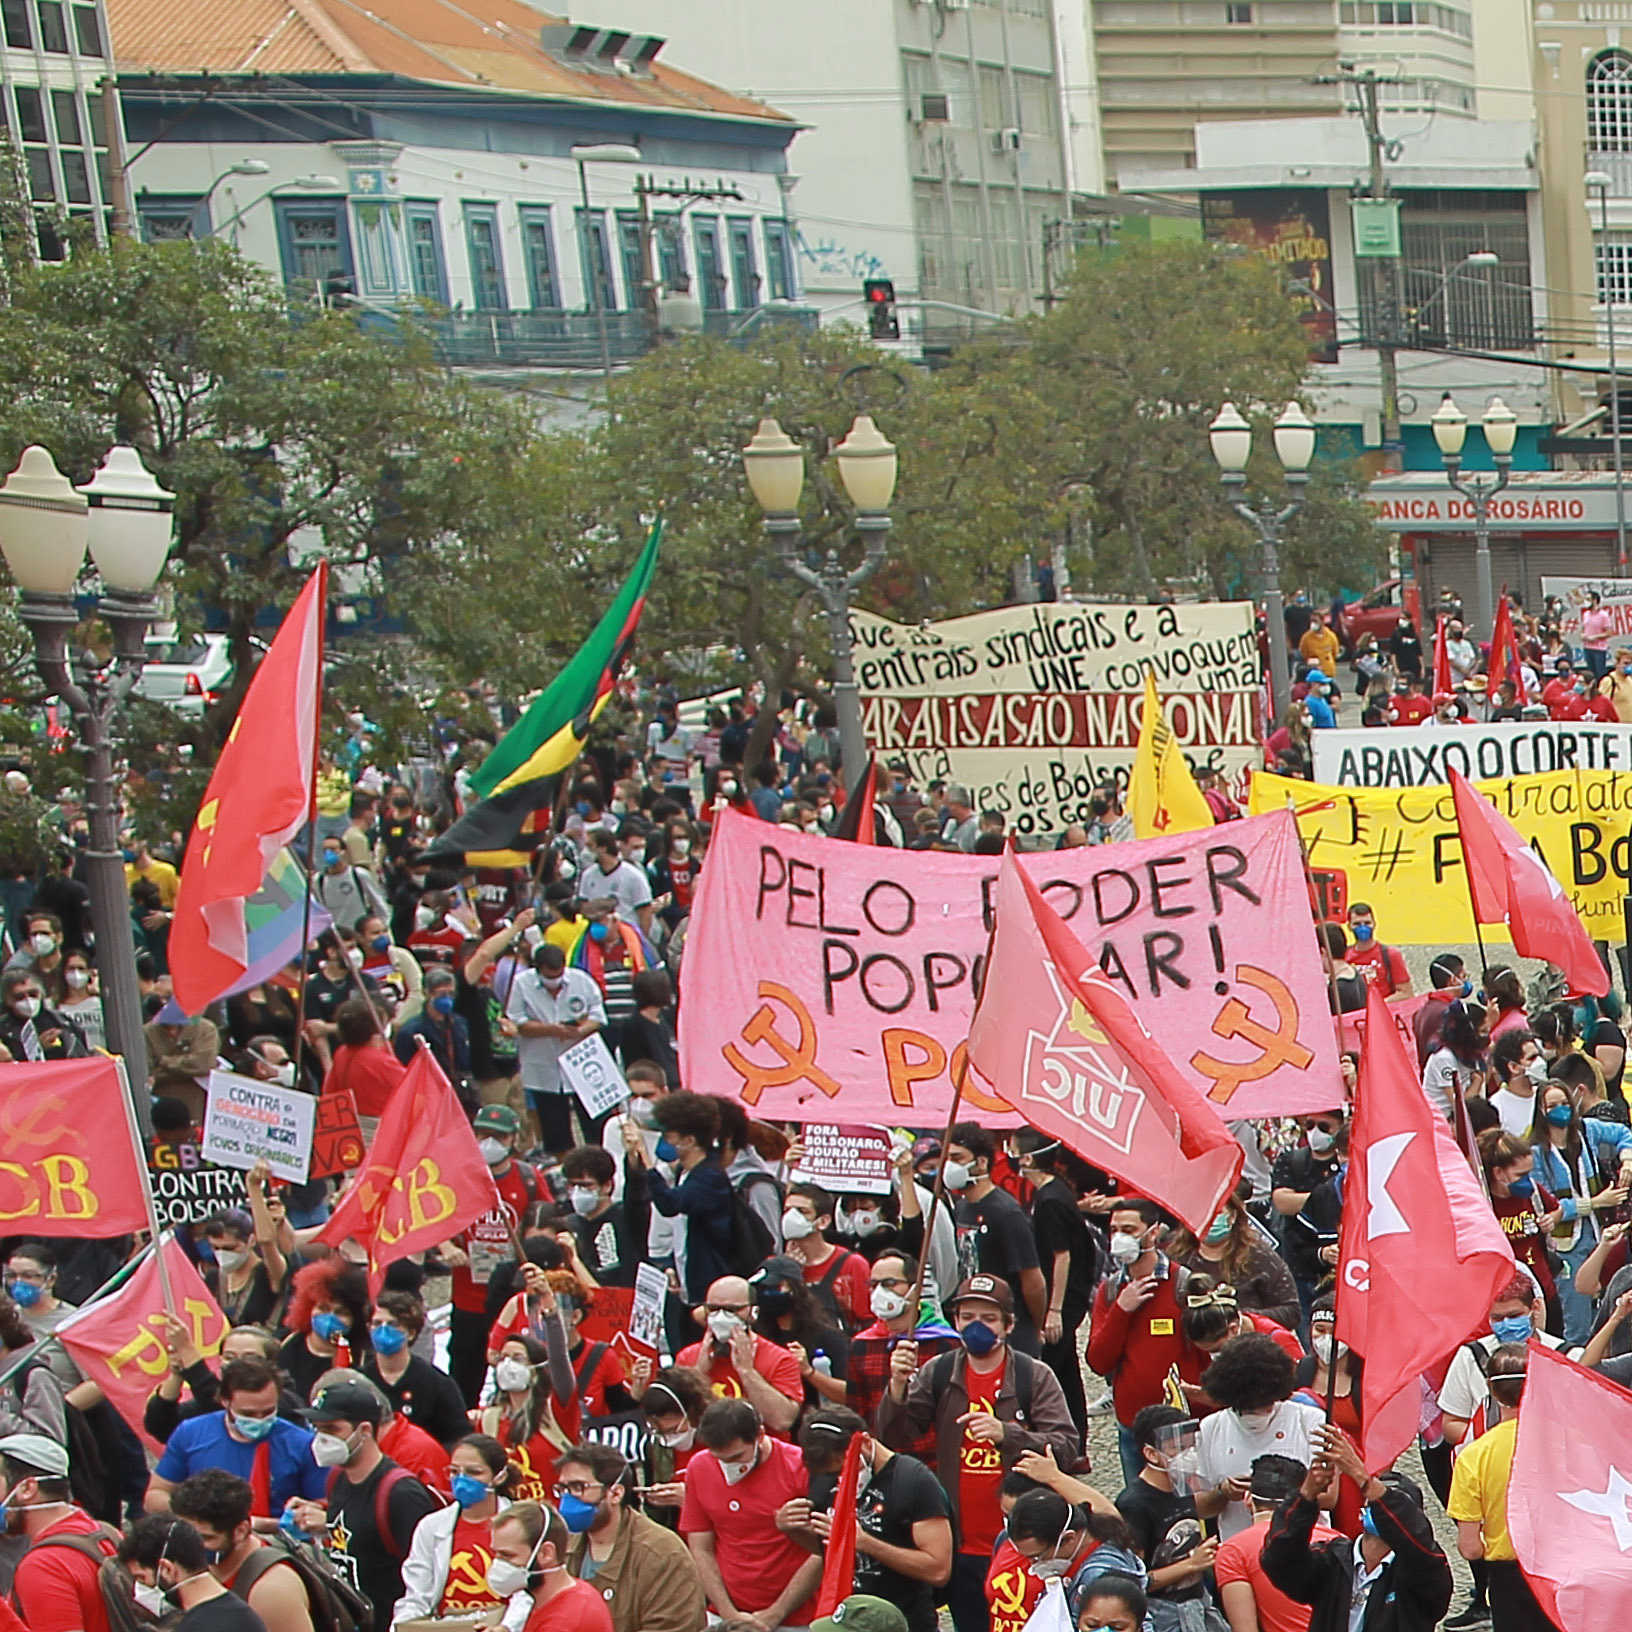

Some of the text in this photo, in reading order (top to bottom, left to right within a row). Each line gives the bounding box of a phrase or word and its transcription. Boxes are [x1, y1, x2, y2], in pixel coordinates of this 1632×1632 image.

[1486, 496, 1585, 520] ROSÁRIO
[855, 606, 1183, 691] entrais sindicais e a
[1028, 630, 1257, 694] UNE convoquem
[1340, 744, 1473, 788] ABAIXO
[1480, 740, 1506, 779] O
[1519, 729, 1620, 777] CORTE
[755, 844, 915, 937] PELO
[228, 1086, 282, 1108] CONTRA
[805, 1124, 840, 1137] FORA
[209, 1134, 242, 1152] POVOS
[804, 1136, 887, 1150] BOLSONARO,
[812, 1158, 887, 1172] MILITARES!
[148, 1169, 246, 1198] CONTRA
